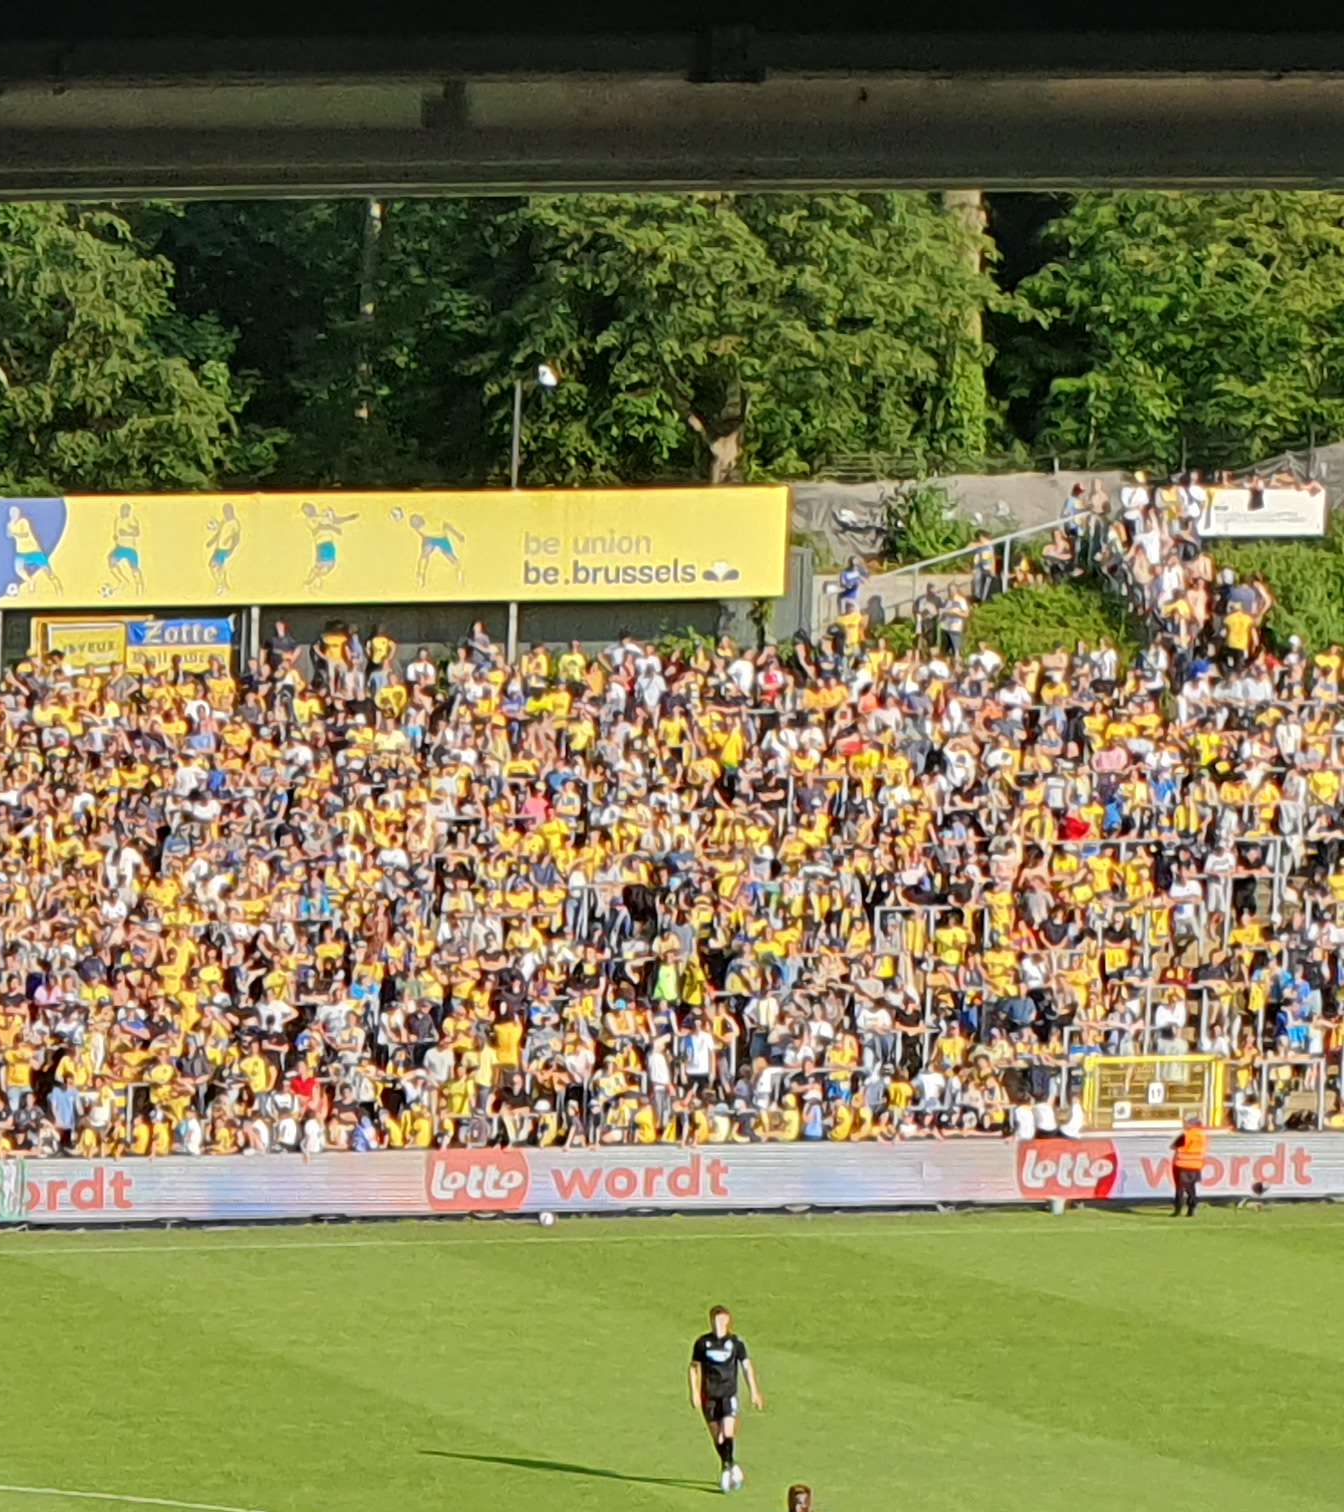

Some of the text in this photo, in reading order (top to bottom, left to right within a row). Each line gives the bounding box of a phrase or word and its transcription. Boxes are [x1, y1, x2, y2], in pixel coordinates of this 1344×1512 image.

[524, 529, 651, 555] be union
[551, 1153, 730, 1200] wordt
